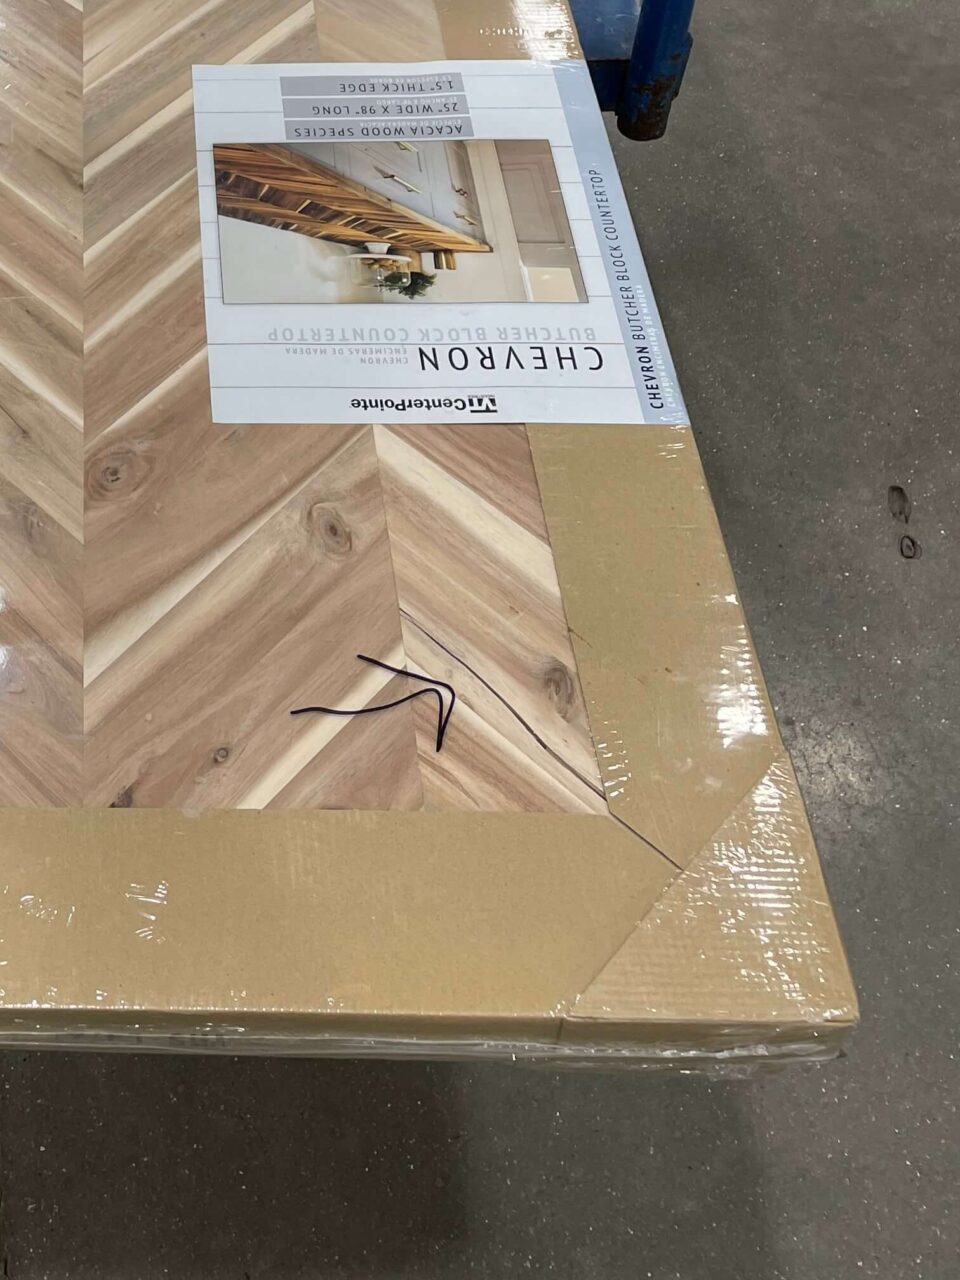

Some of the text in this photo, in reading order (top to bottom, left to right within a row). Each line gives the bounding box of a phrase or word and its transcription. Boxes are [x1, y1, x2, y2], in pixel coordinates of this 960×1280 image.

[339, 83, 375, 92] EDGE
[382, 83, 424, 92] THICK
[311, 106, 350, 115] LONG
[381, 105, 389, 114] X
[396, 104, 433, 113] WIDE
[294, 126, 462, 137] ACACIA WOOD SPECIES
[589, 170, 663, 409] CHEVRON BUTCHER BLOCK COUNTERTOP
[267, 328, 595, 342] BUTCHER BLOCK COUNTERTOP
[348, 347, 407, 355] ENCIMERAS
[419, 346, 603, 370] CHEVRON
[351, 399, 466, 411] CenterPointe
